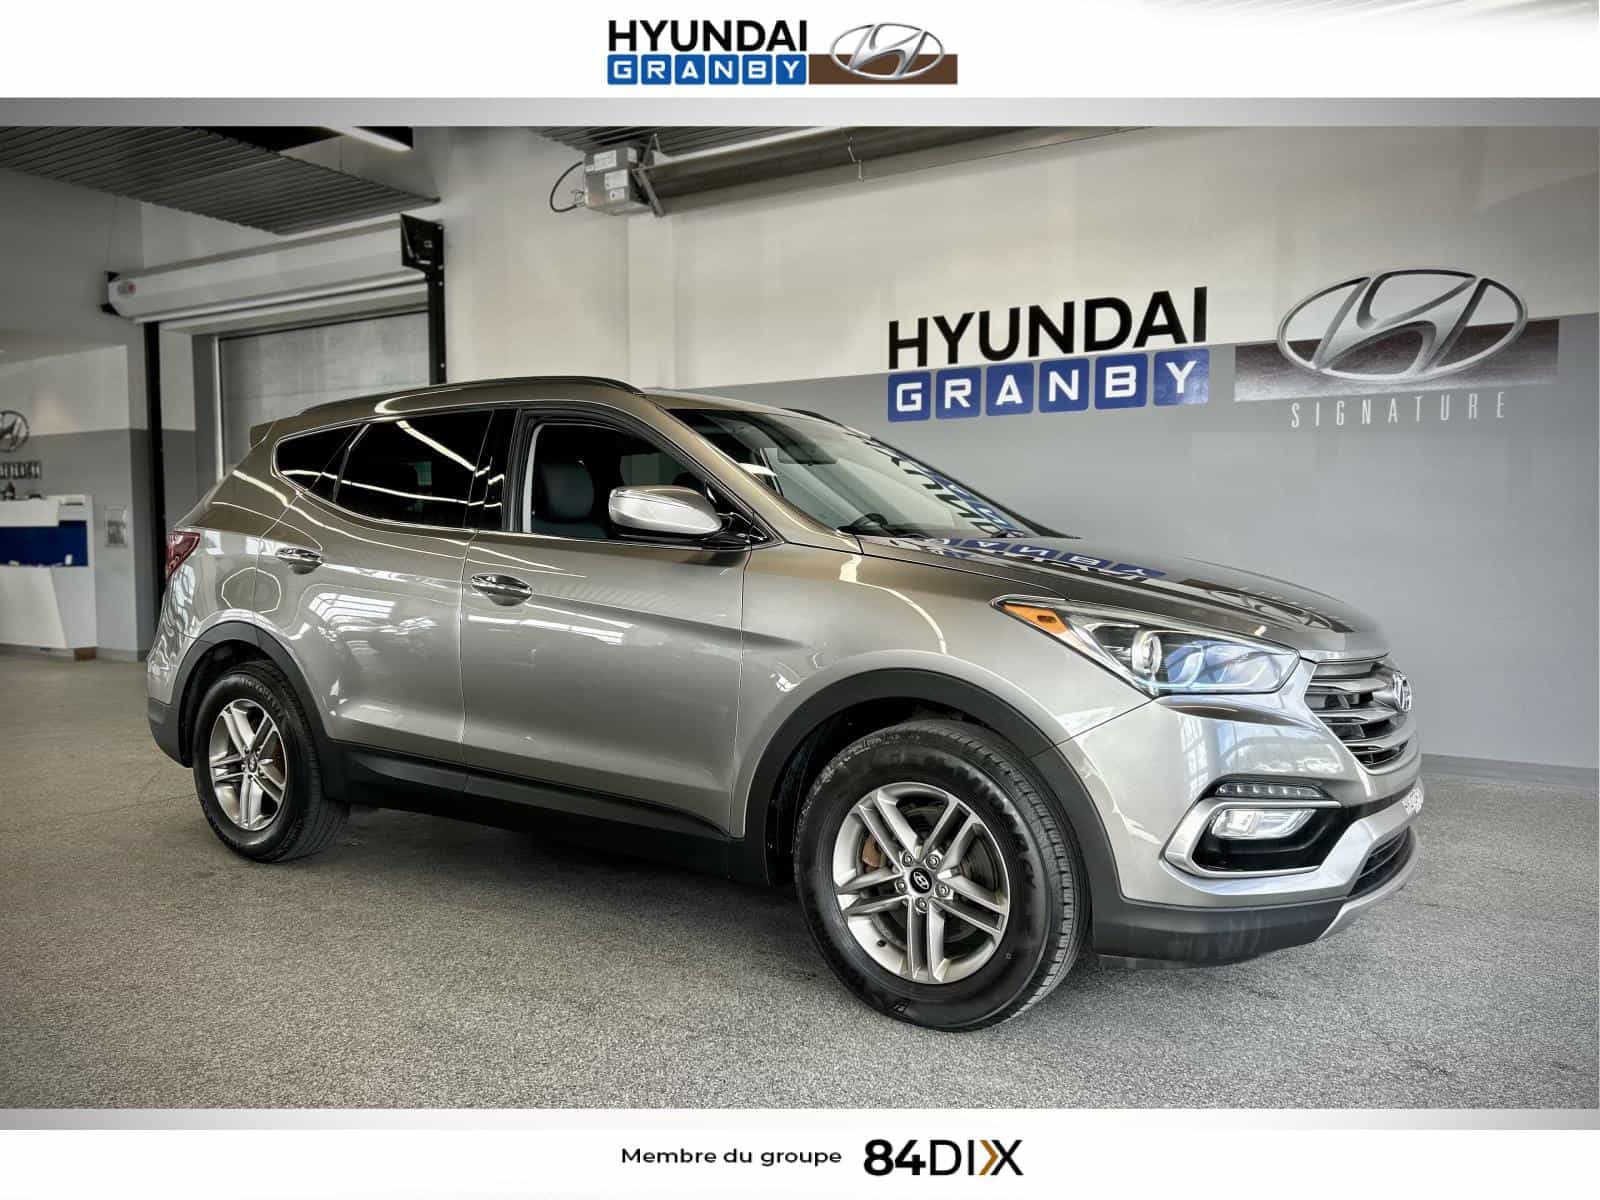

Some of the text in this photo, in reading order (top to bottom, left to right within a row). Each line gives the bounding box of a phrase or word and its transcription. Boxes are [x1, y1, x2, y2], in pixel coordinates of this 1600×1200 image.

[887, 286, 1208, 370] HYUNDAI
[895, 360, 1198, 413] GRANBY
[1290, 391, 1506, 428] SIGNATURE
